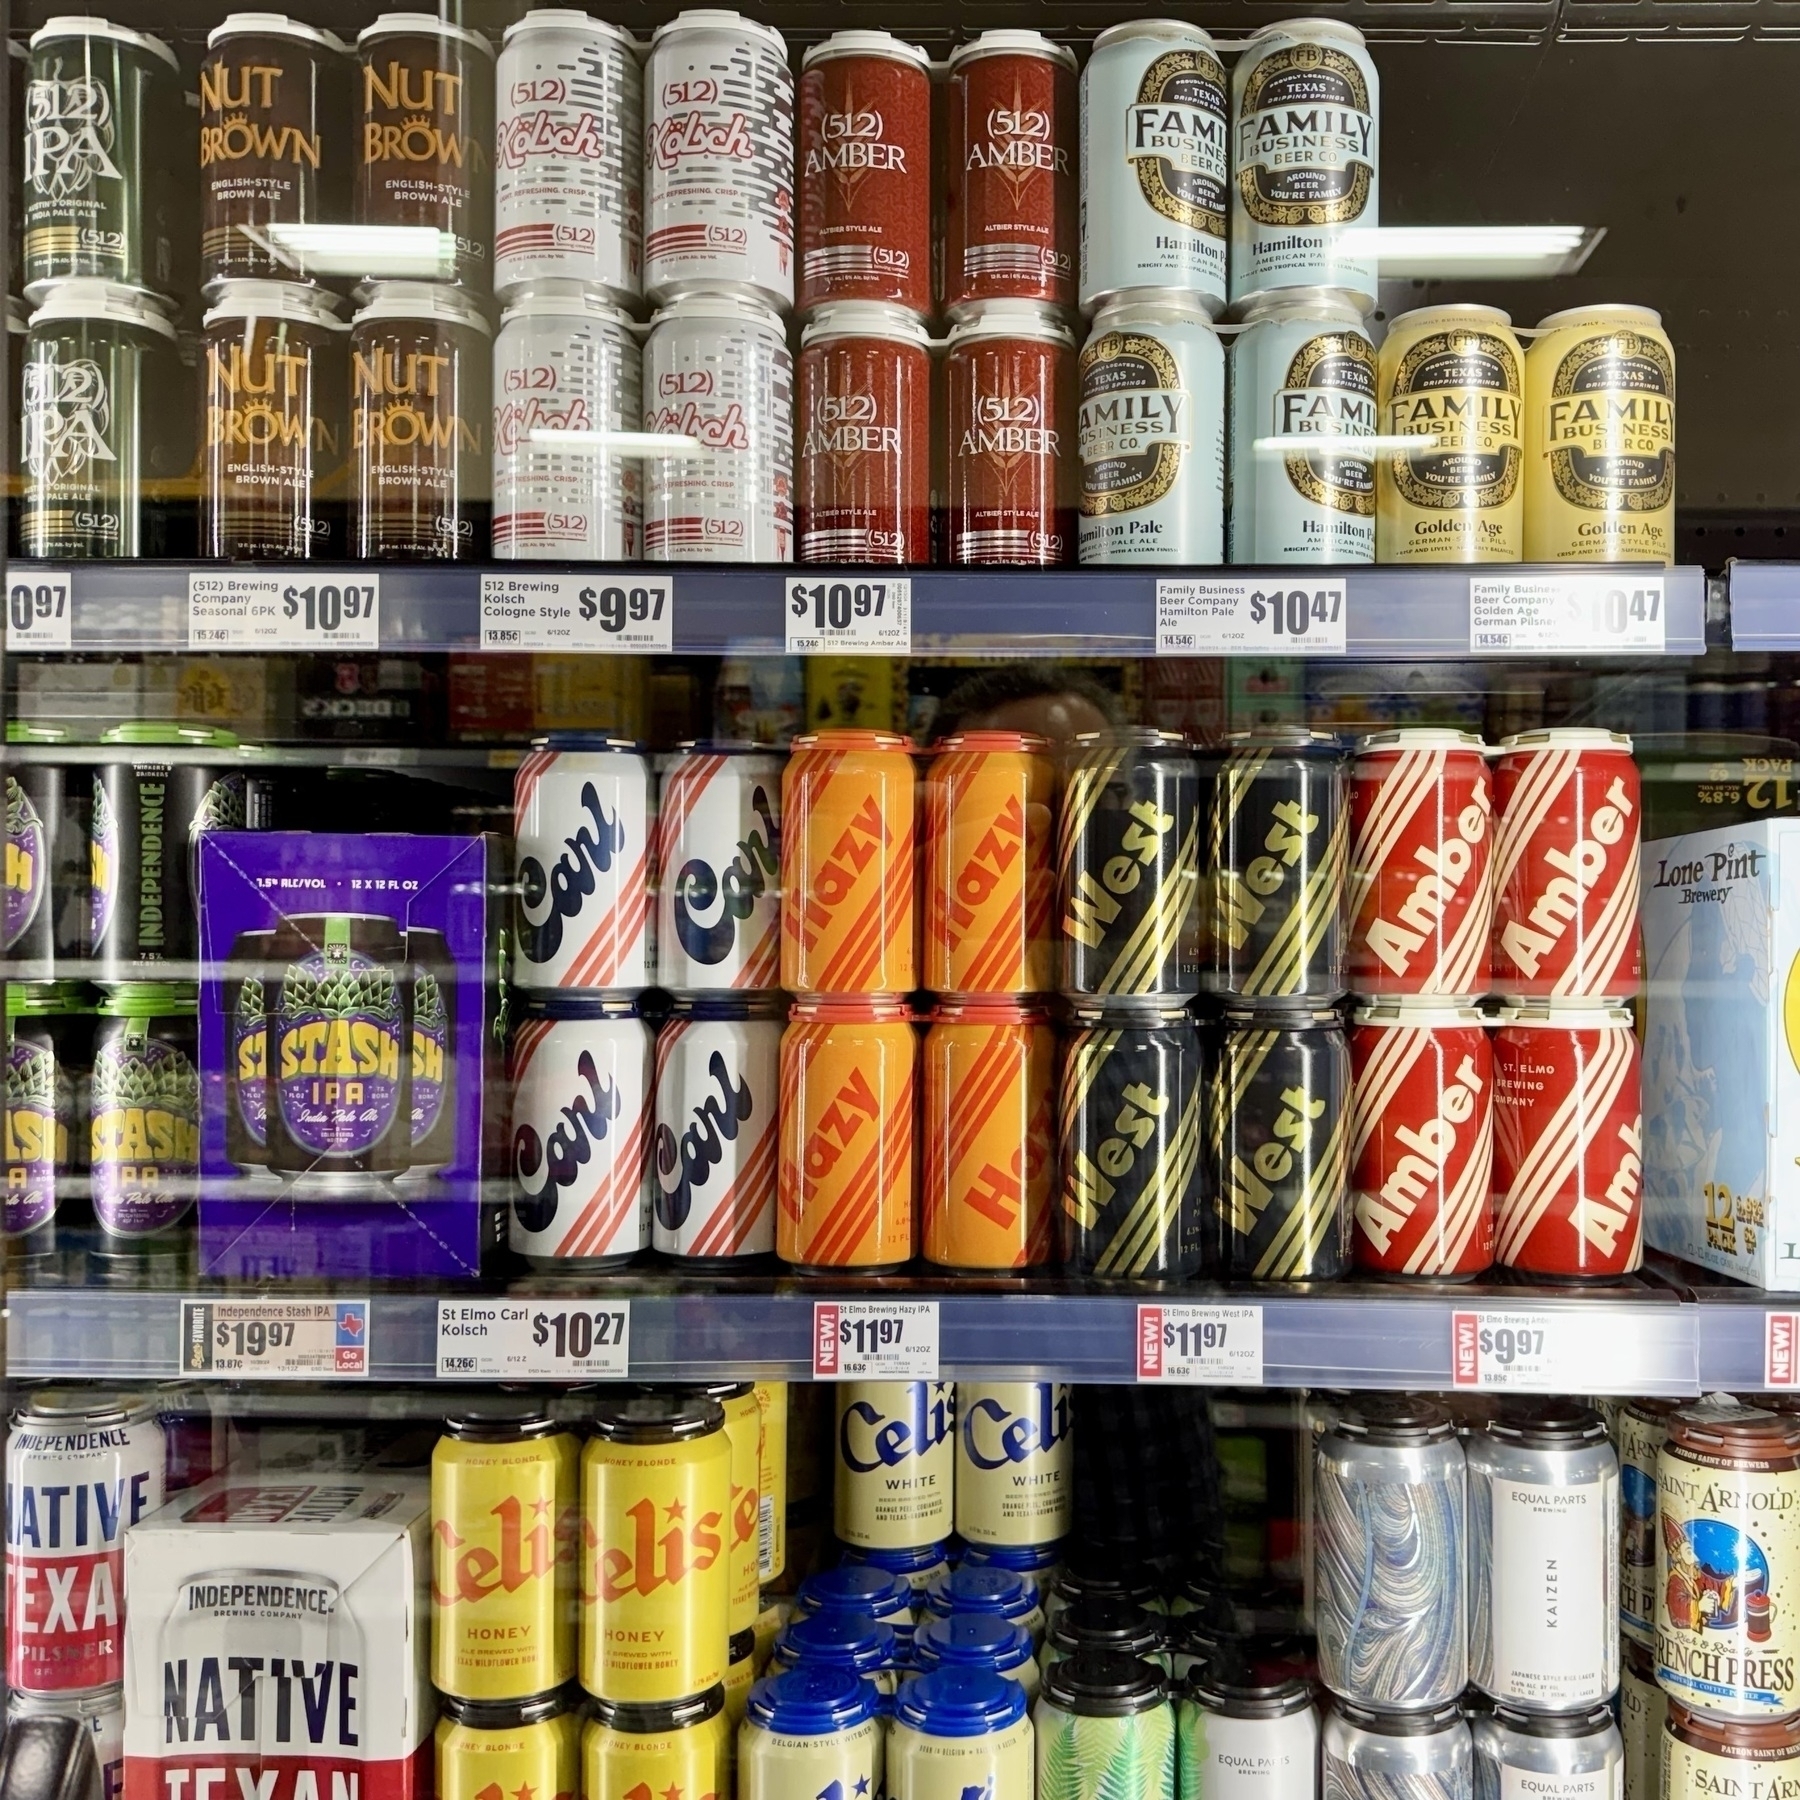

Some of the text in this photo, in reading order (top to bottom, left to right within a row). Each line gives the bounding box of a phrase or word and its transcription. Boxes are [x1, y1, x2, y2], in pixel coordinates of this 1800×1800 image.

[363, 61, 463, 116] NUT
[510, 77, 567, 109] (512)
[662, 77, 719, 109] (512)
[1192, 87, 1221, 106] TEXAS
[1286, 82, 1327, 94] TEXAS
[821, 109, 884, 142] (512)
[986, 108, 1051, 142] (512)
[497, 109, 604, 171] Kölsch
[1238, 108, 1374, 164] FAMILY
[23, 126, 123, 182] IPA
[1248, 134, 1360, 158] BUSINESS
[804, 141, 908, 178] AMBER
[1273, 150, 1314, 166] BEER
[211, 177, 292, 192] ENGLISH-STYLE
[1286, 171, 1327, 184] AROUND
[1293, 180, 1319, 190] BEER
[216, 189, 281, 201] BROWN ALE
[562, 186, 588, 198] CRISP.
[1270, 186, 1343, 201] YOU'RE FAMILY
[845, 225, 883, 235] STYLE ALE
[1252, 235, 1324, 257] Hamilton
[206, 344, 308, 397] NUT
[504, 364, 557, 394] (512)
[816, 393, 878, 425] (512)
[1390, 394, 1523, 443] FAMILY
[1549, 397, 1675, 442] FAMILY
[801, 424, 903, 459] AMBER
[1129, 520, 1164, 536] Pale
[1414, 518, 1504, 536] Golden Age
[193, 580, 279, 593] (512) Brewing
[484, 580, 560, 594] 512 Brewing
[1160, 585, 1246, 597] Family Business
[1474, 584, 1511, 595] Family
[193, 593, 252, 606] Company
[484, 593, 525, 605] Kolsch
[1160, 596, 1240, 607] Beer Company
[1474, 595, 1555, 606] Beer Company
[193, 606, 276, 616] Seasonal 6PK
[484, 606, 571, 619] Cologne Style
[1160, 606, 1235, 616] Hamilton Pale
[1474, 606, 1539, 617] Golden Age
[1159, 617, 1178, 627] Ale
[1474, 617, 1517, 627] German
[840, 640, 869, 648] Brewing
[1741, 757, 1793, 774] PACK
[138, 783, 166, 948] INDEPENDENCE
[514, 780, 626, 965] Carl
[784, 792, 895, 955] Hazy
[1061, 798, 1175, 951] West
[1653, 842, 1767, 889] Lone Pint
[281, 878, 419, 891] ALC/VOL 12 FL OZ
[1364, 775, 1493, 979] Amber
[1499, 775, 1634, 981] Amber
[1678, 886, 1734, 905] Brewery
[281, 1018, 399, 1081] STASH
[1503, 1062, 1555, 1075] ST. ELMO
[312, 1081, 365, 1105] IPA
[1496, 1078, 1545, 1091] BREWING
[512, 1049, 622, 1234] Carl
[780, 1065, 882, 1226] Hazy
[1060, 1081, 1170, 1232] West
[1703, 1181, 1735, 1231] 12
[217, 1305, 331, 1318] Independence Stash IPA
[441, 1308, 529, 1321] St Elmo Carl
[840, 1306, 931, 1315] St Elmo Brewing Hazy IPA
[1163, 1309, 1255, 1319] St Elmo Brewing West IPA
[192, 1306, 205, 1343] FAVORITE
[441, 1323, 488, 1336] Kolsch
[819, 1313, 836, 1367] NEW!
[1143, 1316, 1159, 1370] NEW!
[342, 1350, 358, 1360] Go
[1458, 1322, 1475, 1377] NEW!
[336, 1359, 363, 1370] Local
[14, 1428, 132, 1451] INDEPENDENCE
[465, 1454, 542, 1467] HONEY BLONDE
[1673, 1446, 1770, 1470] PATRON SAINT OF BREWERS
[885, 1474, 936, 1490] WHITE
[1657, 1466, 1793, 1513] SAINT ARNOLD
[1511, 1491, 1587, 1505] EQUAL PARTS
[1532, 1506, 1567, 1514] BREWING
[578, 1497, 723, 1606] Celis
[188, 1584, 329, 1616] INDEPENDENCE
[1546, 1558, 1558, 1629] KAIZEN
[213, 1609, 303, 1620] BREWING COMPANY
[467, 1625, 532, 1640] HONEY
[1673, 1630, 1698, 1648] Rich
[1728, 1656, 1795, 1692] PRESS
[164, 1656, 359, 1747] NATIVE
[771, 1725, 873, 1749] BELGIAN-STYLE WITBIER
[1217, 1753, 1255, 1768] EQUAL
[1238, 1768, 1271, 1776] BREWING
